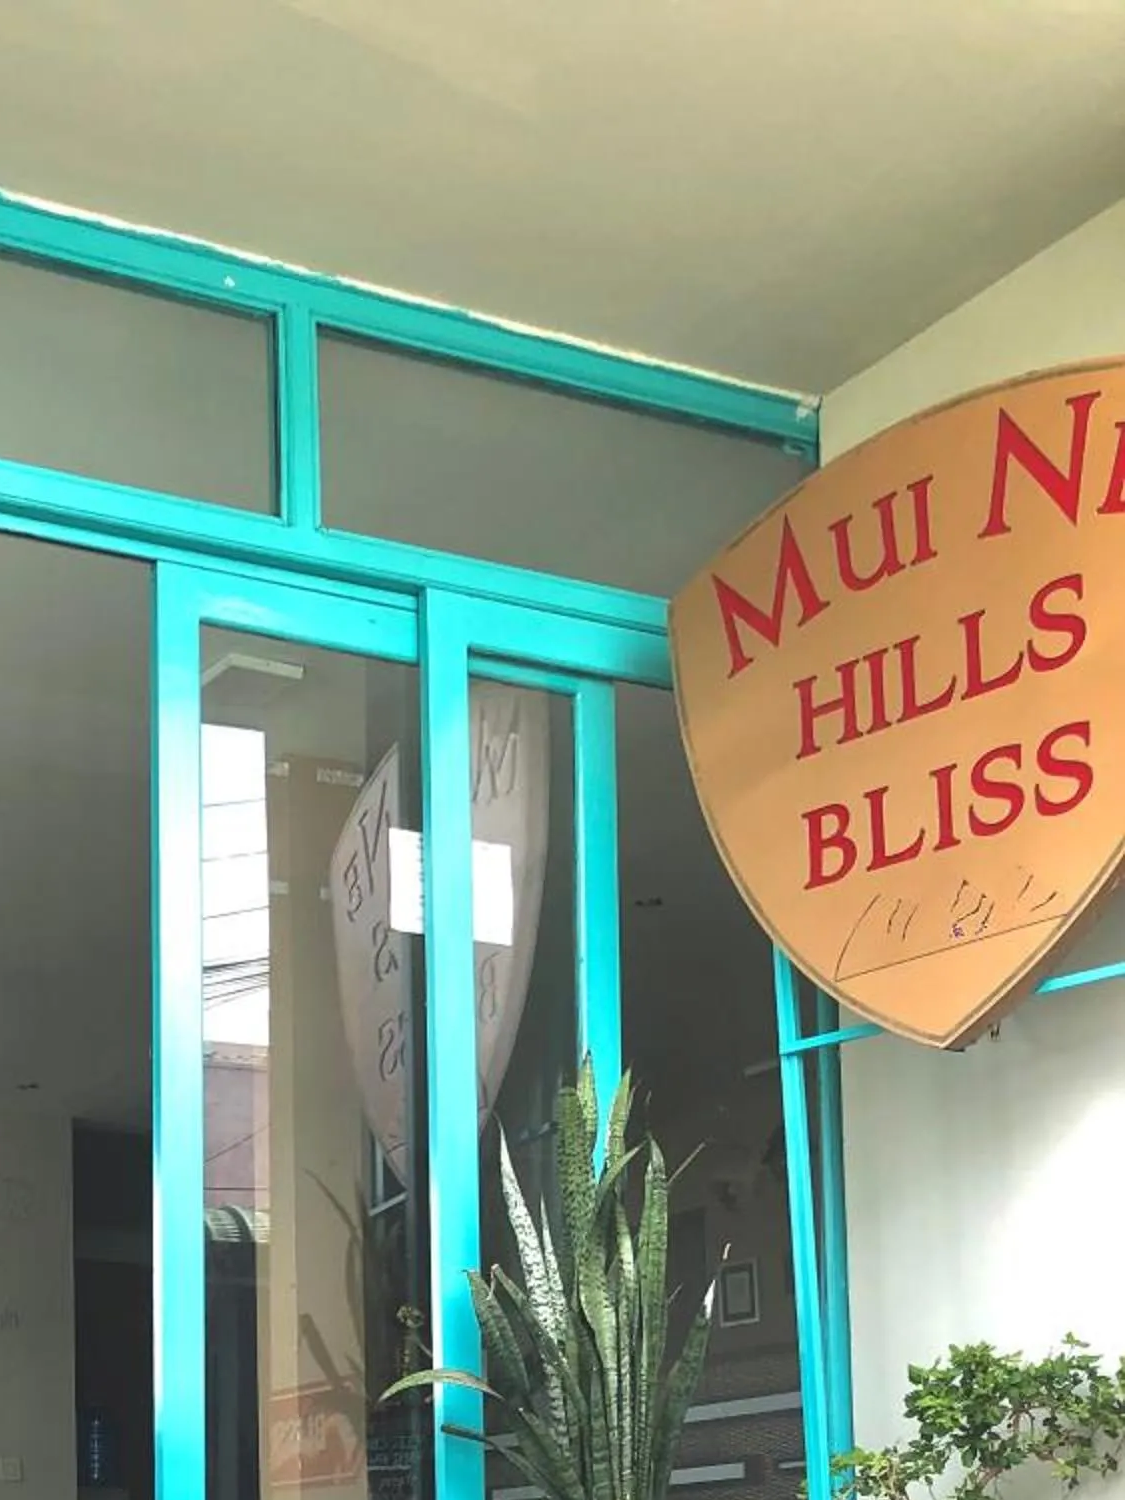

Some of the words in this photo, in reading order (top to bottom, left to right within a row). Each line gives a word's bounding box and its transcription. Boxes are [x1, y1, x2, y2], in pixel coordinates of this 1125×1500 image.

[711, 474, 937, 678] MUI
[794, 574, 1087, 759] HILLS
[802, 721, 1092, 890] BLISS
